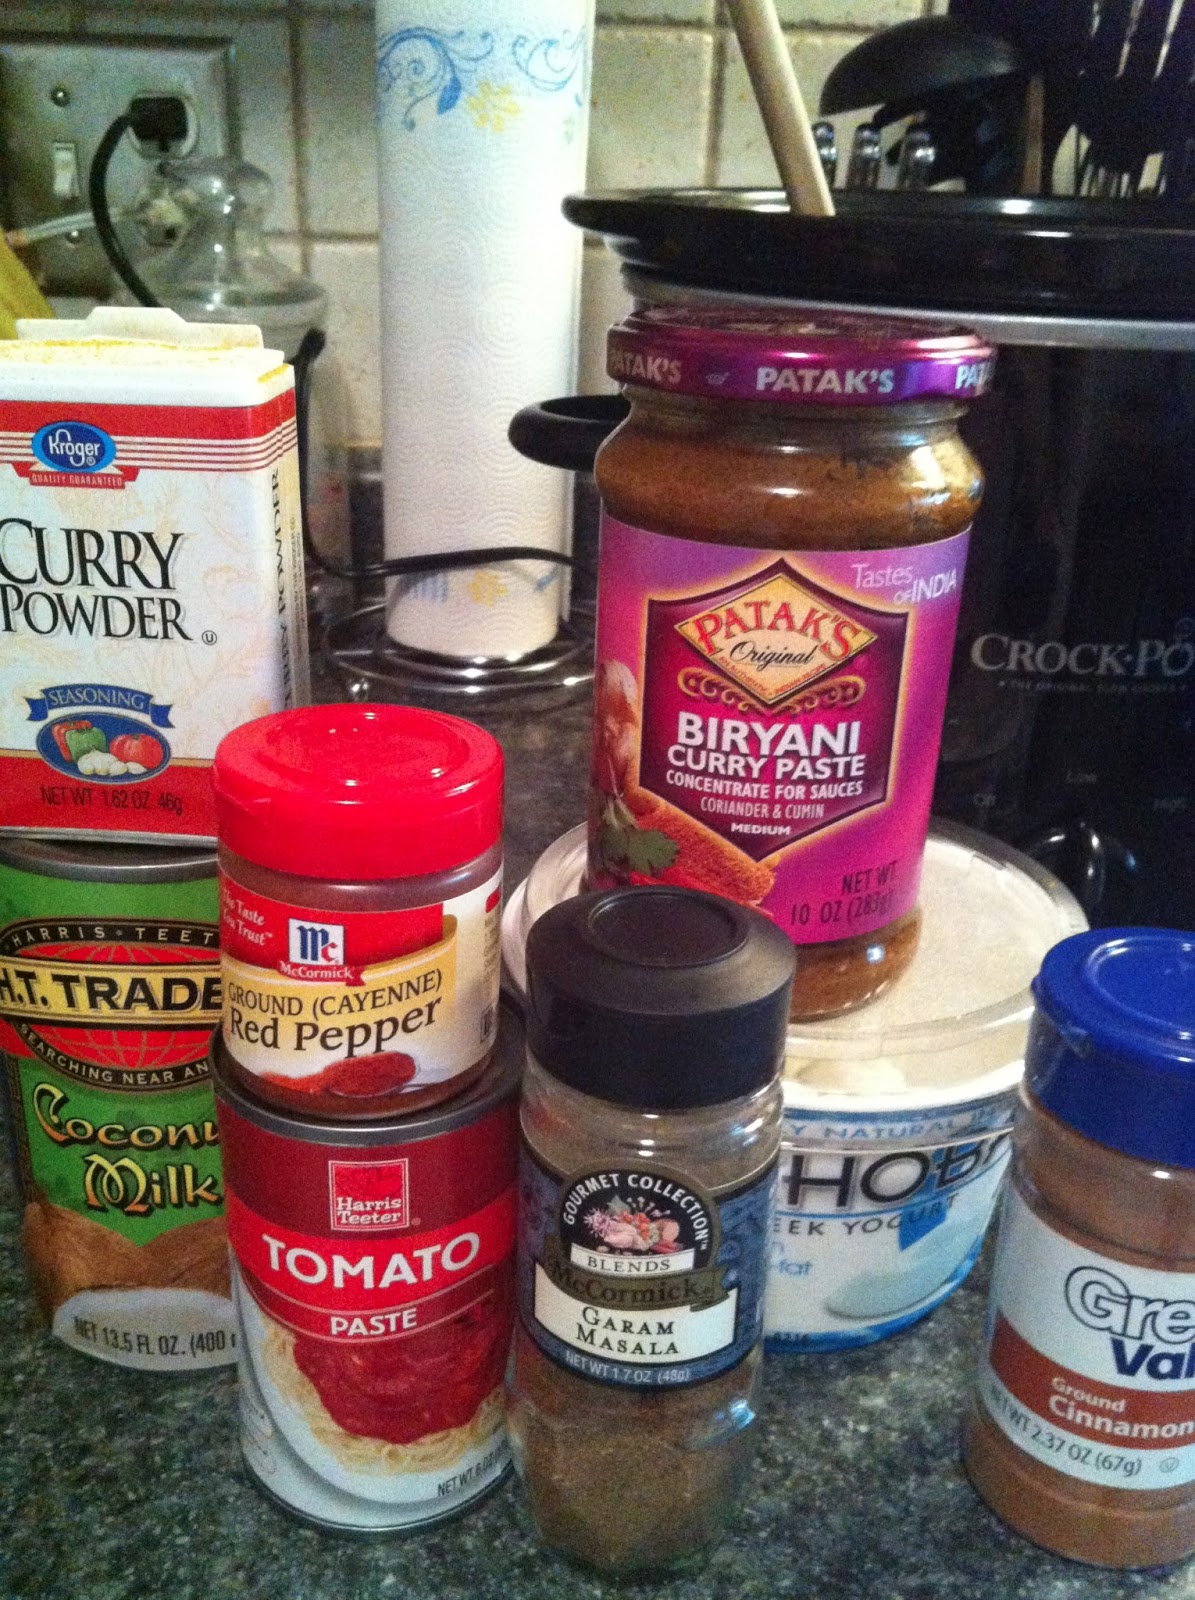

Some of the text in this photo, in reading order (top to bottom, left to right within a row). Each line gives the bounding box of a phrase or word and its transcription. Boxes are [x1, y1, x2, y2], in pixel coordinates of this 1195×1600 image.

[756, 366, 894, 394] PATAK'S
[48, 428, 101, 467] Kroger
[0, 518, 185, 590] CURRY
[851, 563, 914, 589] Tastes
[911, 568, 957, 603] INDIA
[0, 584, 193, 641] POWDER
[692, 600, 863, 661] PATAK'S
[729, 640, 820, 672] Original
[48, 687, 146, 711] SEASONING
[677, 711, 862, 758] BIRYANI
[667, 744, 866, 781] CURRY PASTE
[40, 786, 68, 806] NET
[71, 787, 93, 806] WT
[130, 790, 150, 810] OZ
[158, 791, 184, 816] 46g
[666, 769, 863, 801] CONCENTRATE FOR SAUCES
[700, 796, 825, 819] CORIANDER & CUMIN
[730, 822, 791, 836] MEDIUM
[841, 859, 898, 896] NET WT
[236, 900, 265, 926] Taste
[790, 903, 811, 926] 10
[820, 899, 843, 924] OZ
[12, 926, 106, 947] HARRIS
[279, 960, 353, 980] McCormick
[0, 968, 221, 1011] H.T. TRADE
[228, 968, 443, 1021] GROUND (CAYENNE)
[230, 996, 443, 1059] Red Pepper
[20, 1023, 113, 1083] SEARCHING
[122, 1071, 175, 1085] NEAR
[84, 1153, 222, 1215] Milk
[563, 1173, 620, 1226] GOURMET
[336, 1196, 402, 1213] Harris
[337, 1210, 402, 1226] Teeter
[262, 1231, 481, 1290] TOMATO
[587, 1255, 671, 1273] BLENDS
[551, 1261, 699, 1301] McCormick
[73, 1316, 97, 1343] NET
[330, 1308, 418, 1337] PASTE
[582, 1305, 675, 1335] GARAM
[576, 1323, 680, 1355] MASALA
[566, 1350, 586, 1370] NET
[589, 1360, 610, 1377] WT
[633, 1370, 653, 1383] OZ
[1051, 1376, 1127, 1413] Ground
[1049, 1394, 1194, 1439] Cinnamon
[1067, 1443, 1093, 1464] OZ
[1095, 1448, 1143, 1477] (67g)
[437, 1476, 458, 1498] NET
